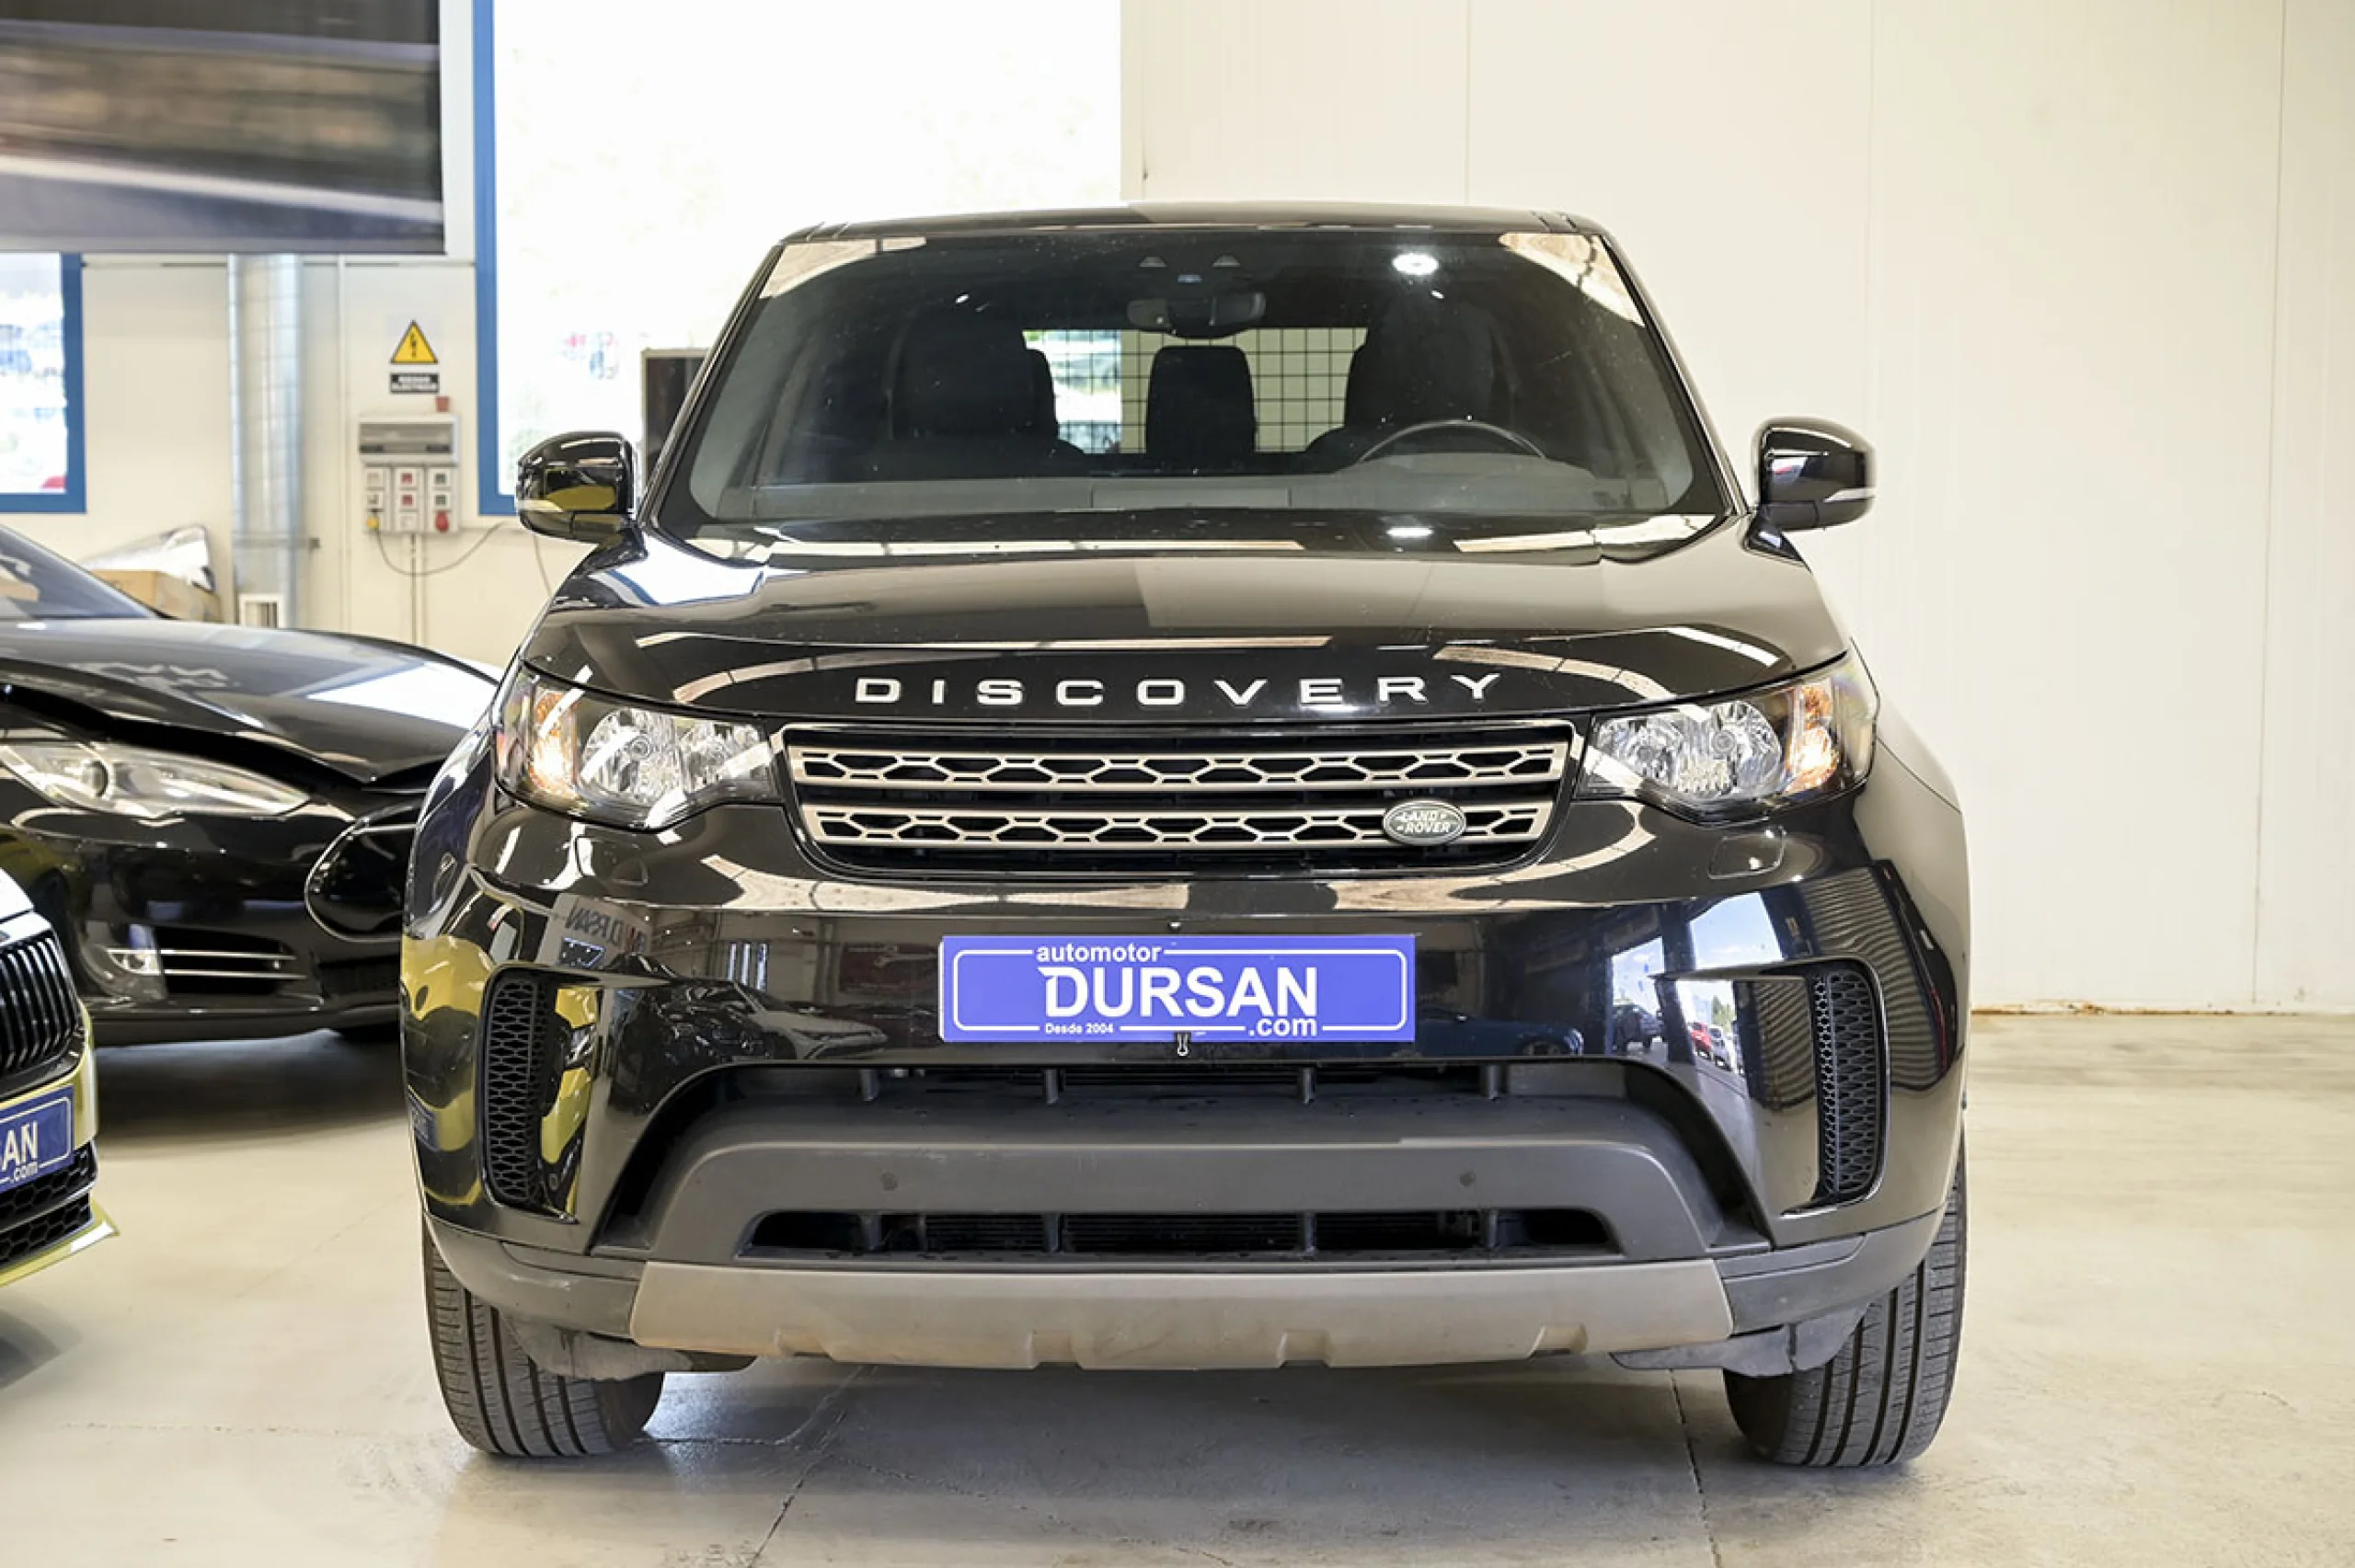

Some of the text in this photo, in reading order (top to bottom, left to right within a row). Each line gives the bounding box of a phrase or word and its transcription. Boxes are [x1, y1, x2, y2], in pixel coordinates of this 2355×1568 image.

[855, 673, 1500, 706] DISCOVERY
[1036, 944, 1163, 963] automotor
[1037, 967, 1317, 1018] DURSAN
[1045, 1023, 1114, 1035] Desde 2004
[1248, 1017, 1317, 1036] .com
[0, 1120, 39, 1172] AN
